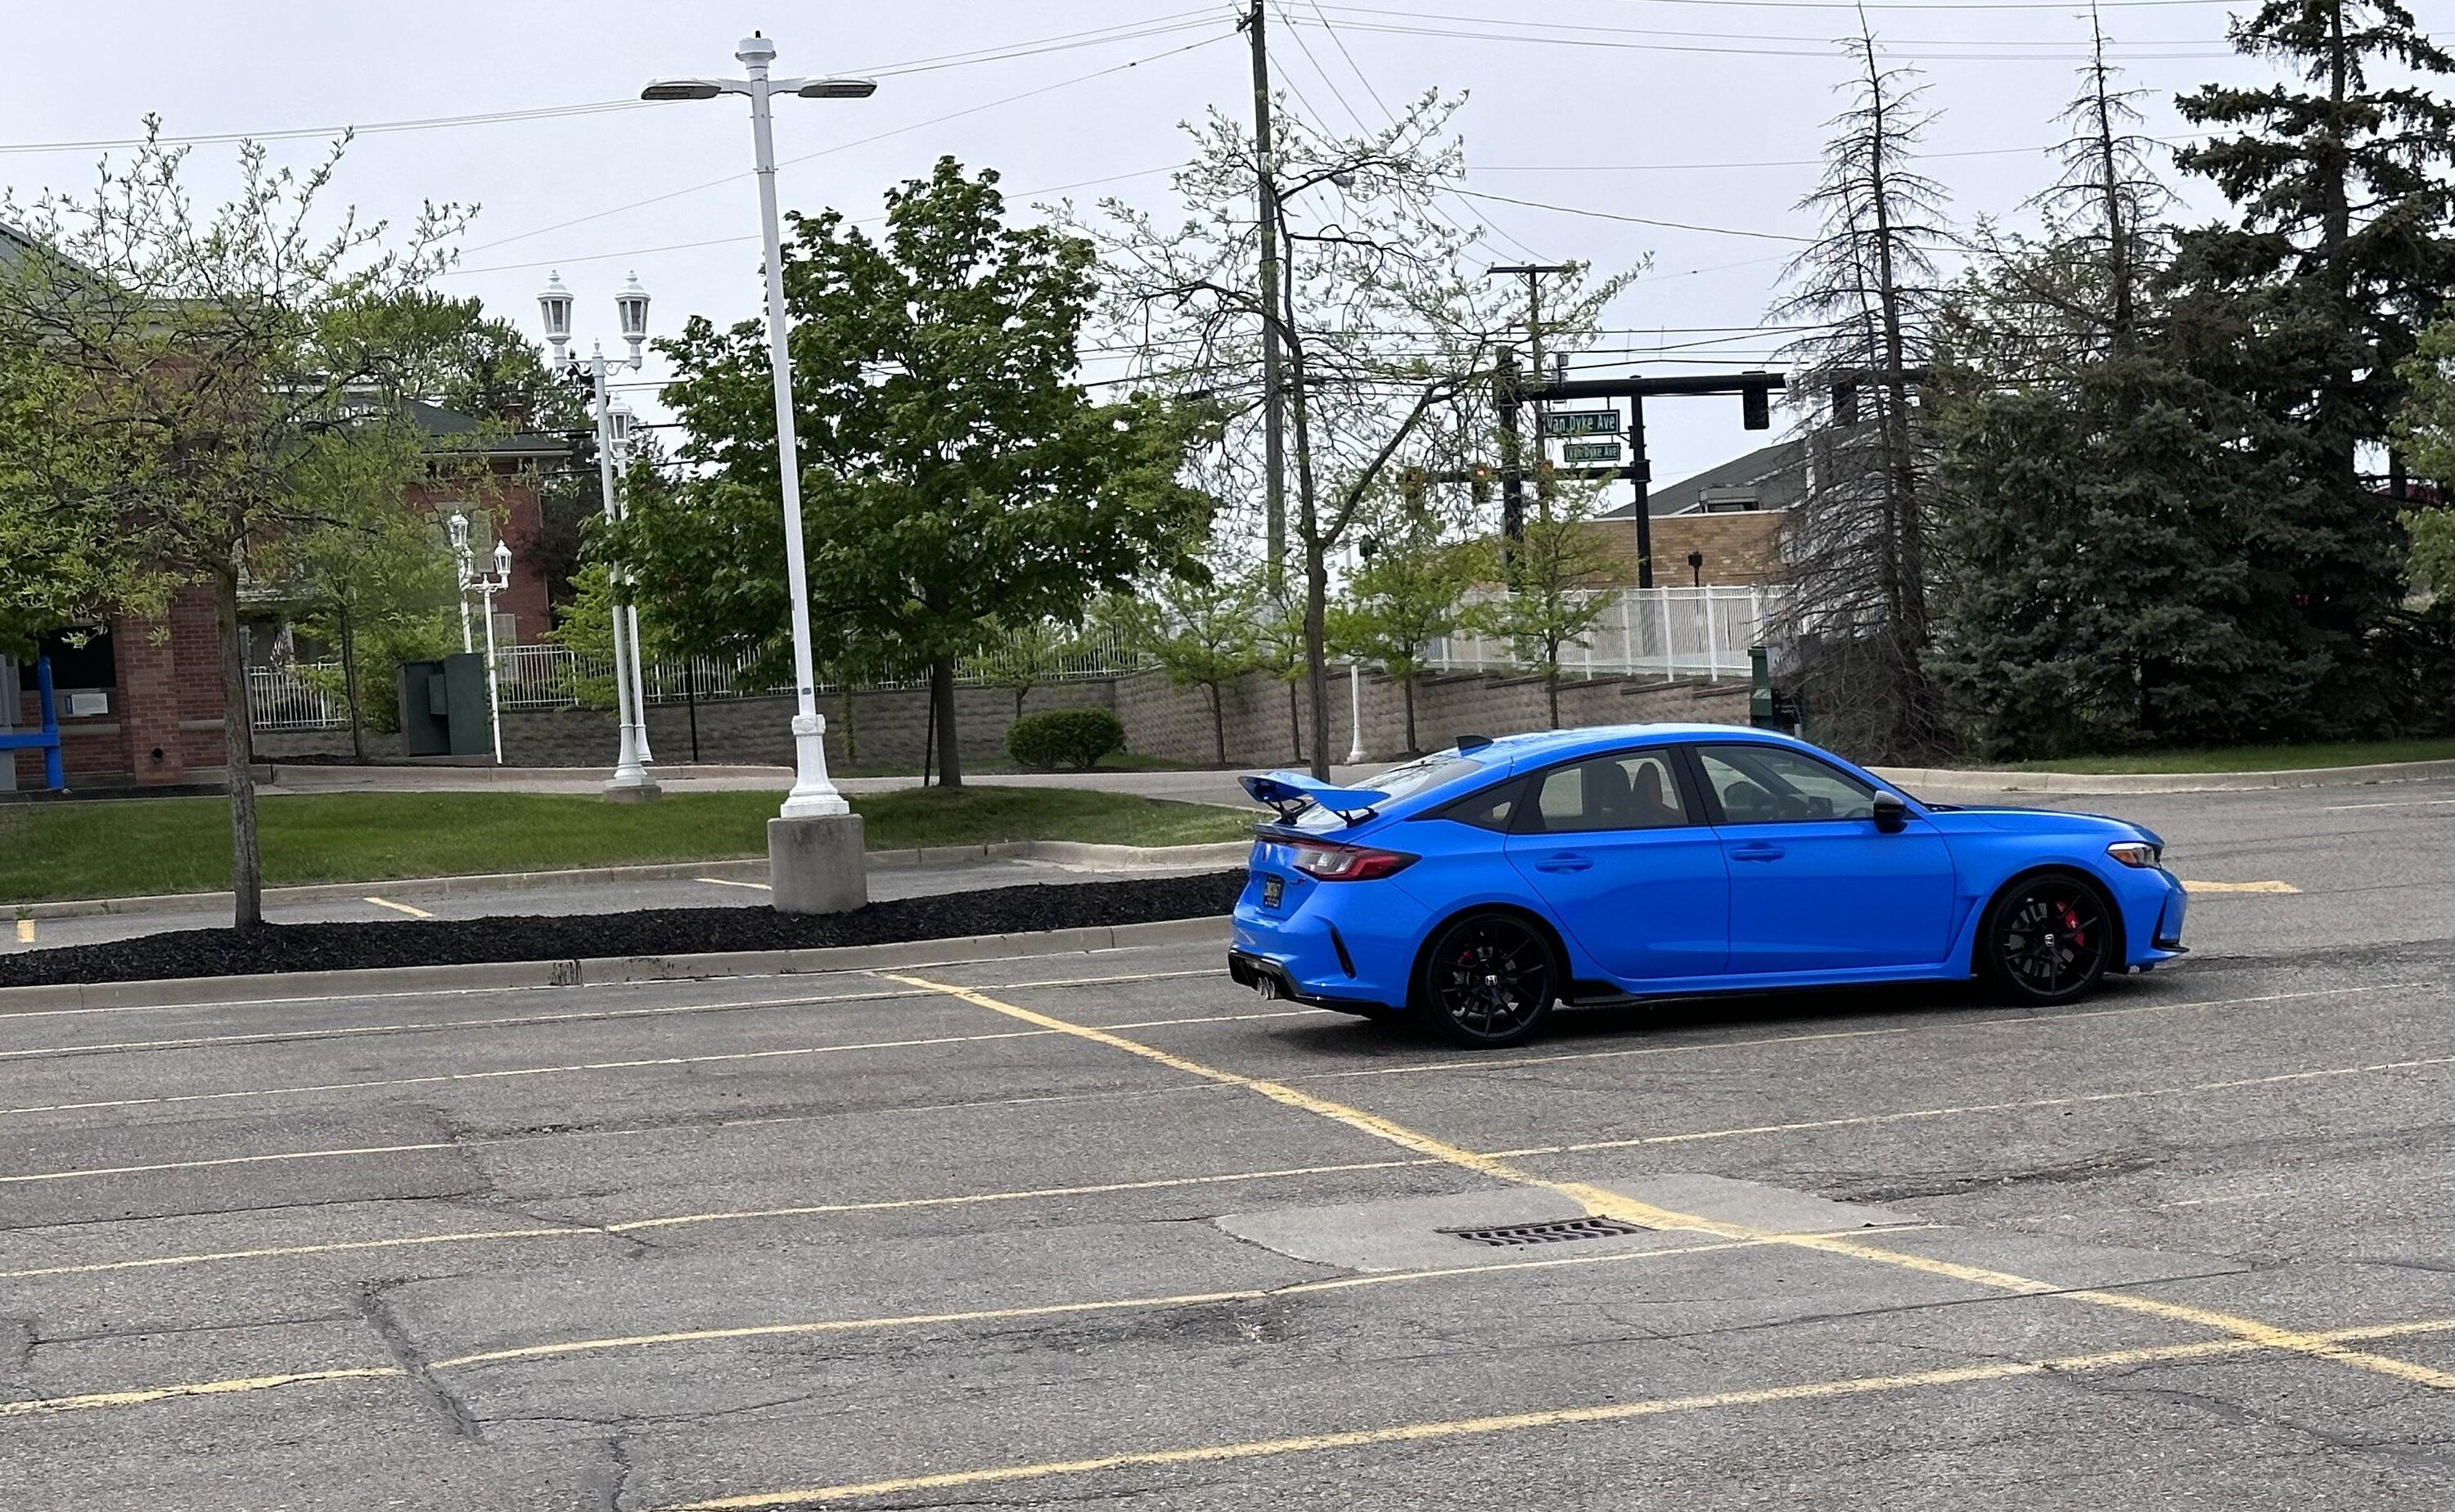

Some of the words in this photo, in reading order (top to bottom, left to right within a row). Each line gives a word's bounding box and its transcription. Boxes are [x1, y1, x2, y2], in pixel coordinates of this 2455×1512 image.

[1546, 416, 1565, 431] Van
[1570, 415, 1593, 432] Dyke
[1597, 414, 1615, 430] Ave
